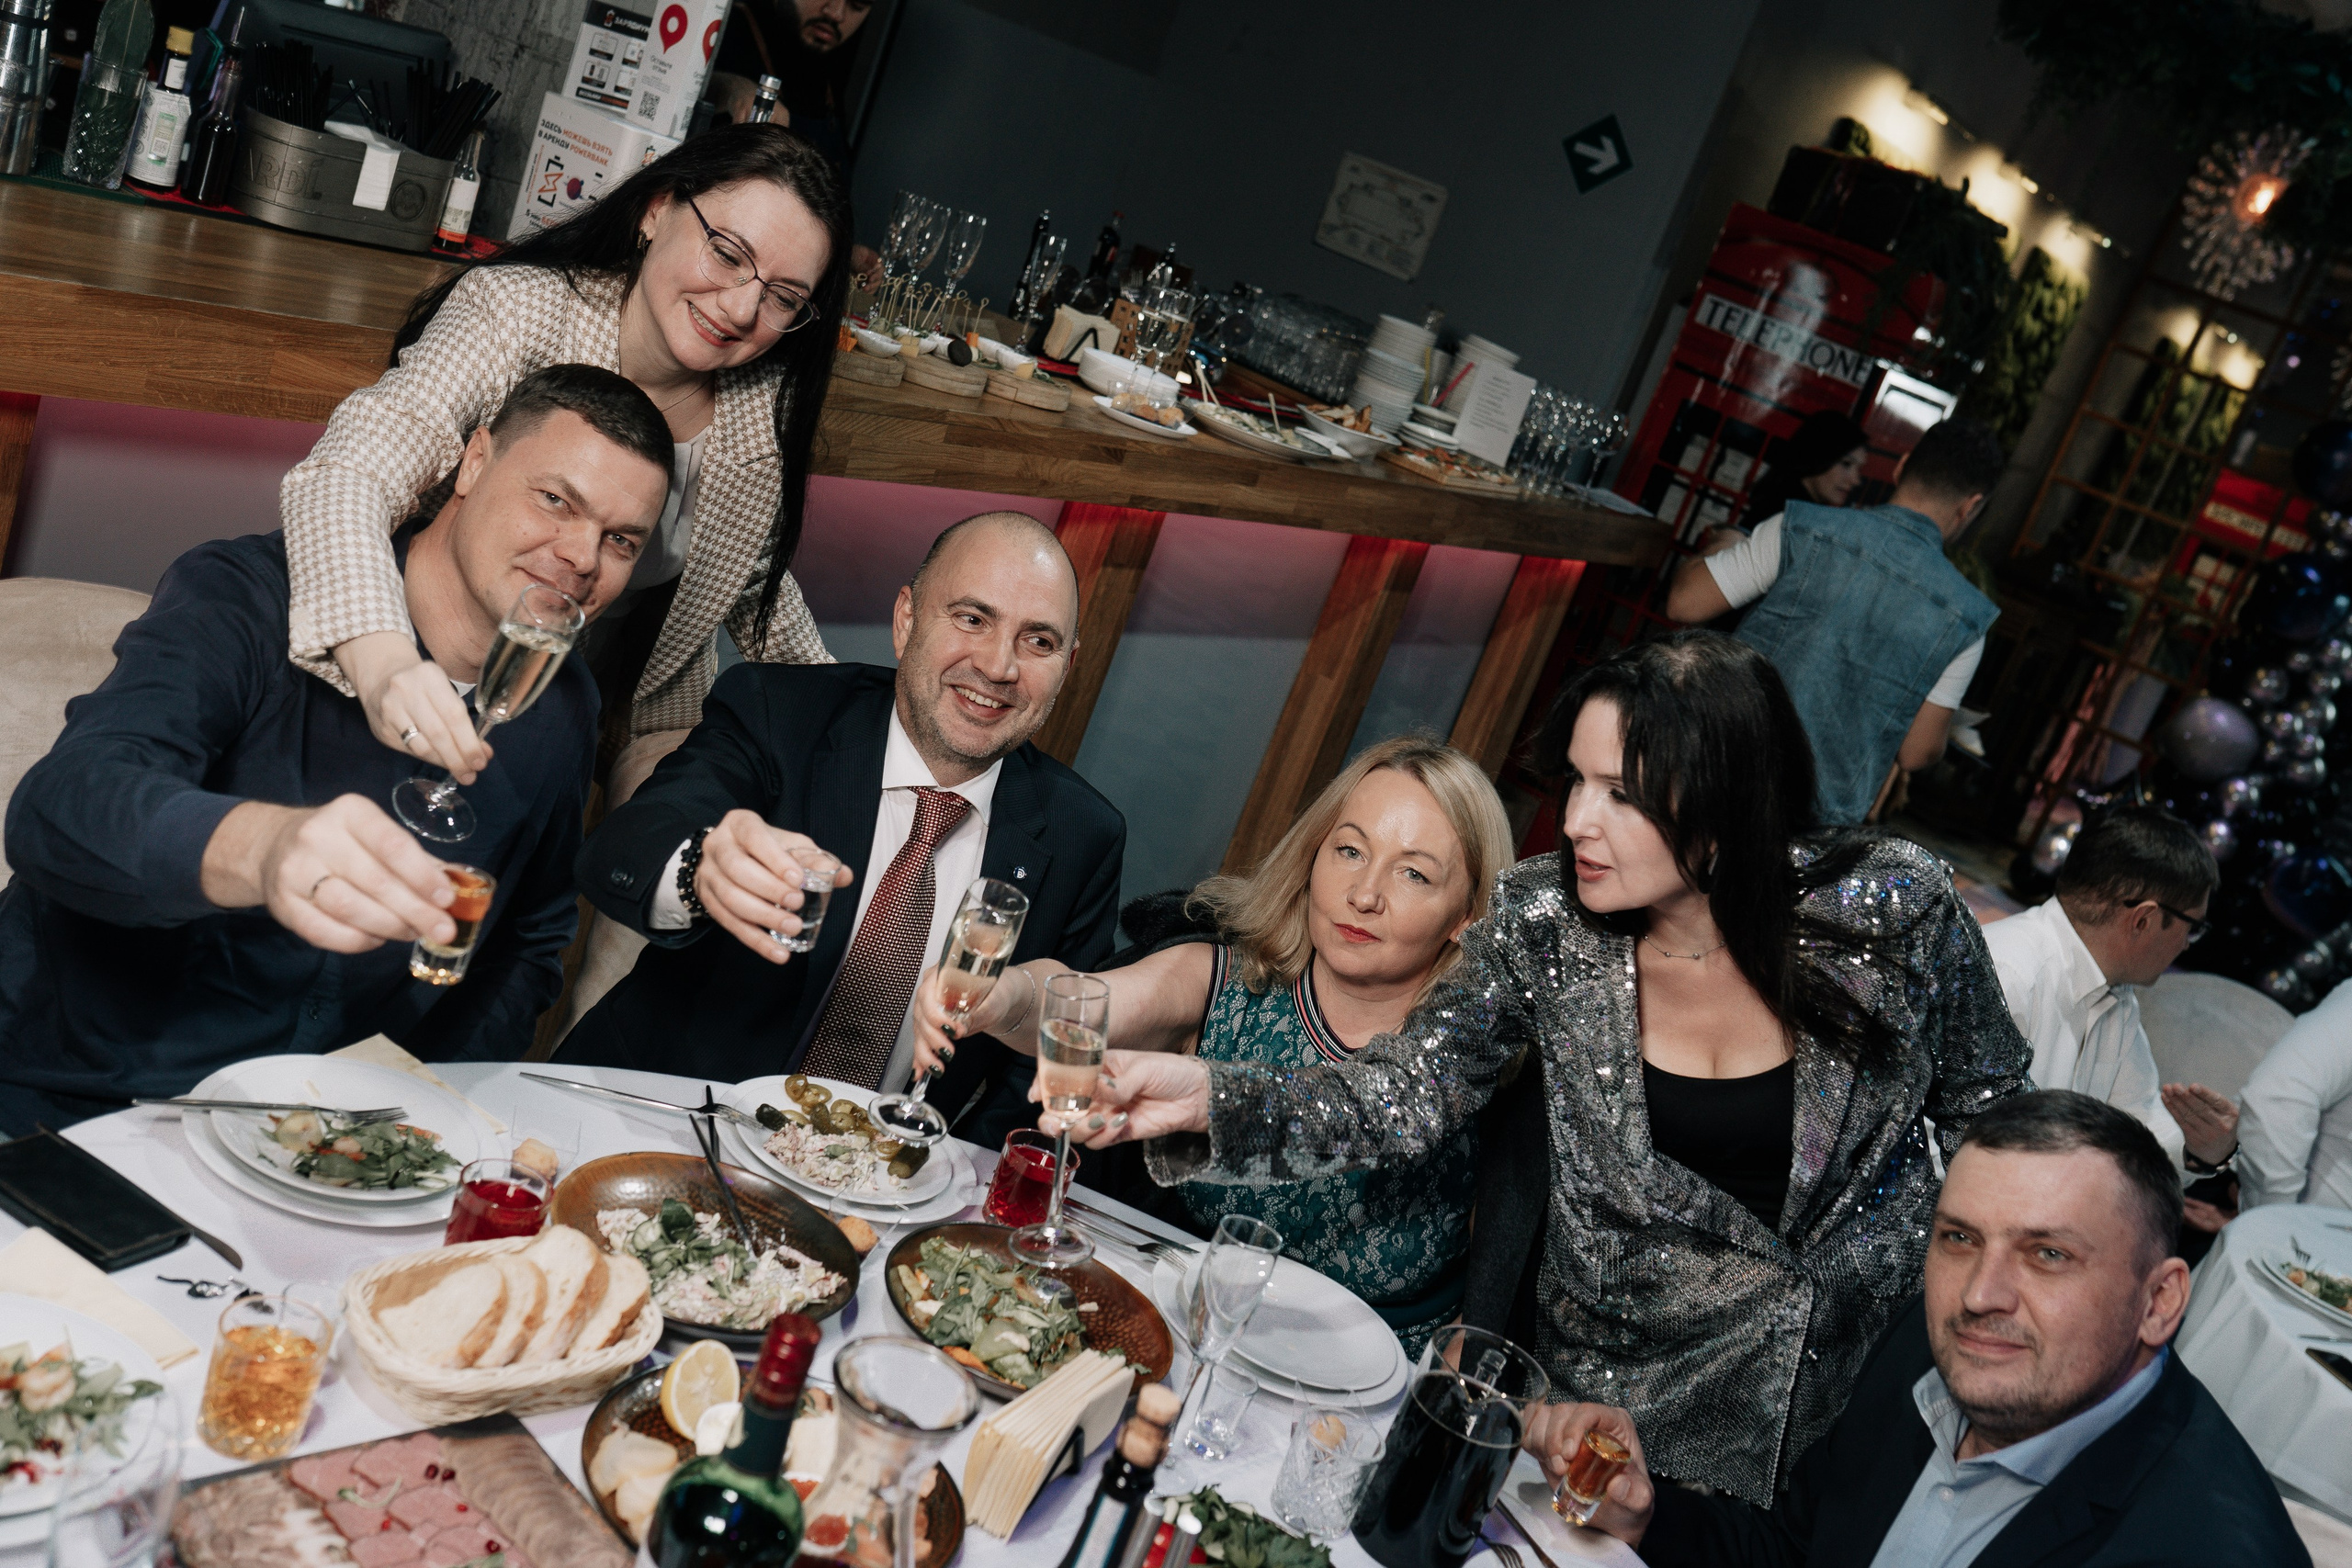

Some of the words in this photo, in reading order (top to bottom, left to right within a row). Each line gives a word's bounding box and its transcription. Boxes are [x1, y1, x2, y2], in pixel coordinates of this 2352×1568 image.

[537, 130, 543, 138] В
[543, 132, 570, 150] АРЕНДУ
[570, 143, 608, 167] POWERBANK
[540, 118, 562, 134] ЗДЕСЬ
[562, 127, 592, 147] МОЖЕШЬ
[592, 137, 613, 156] ВЗЯТЬ
